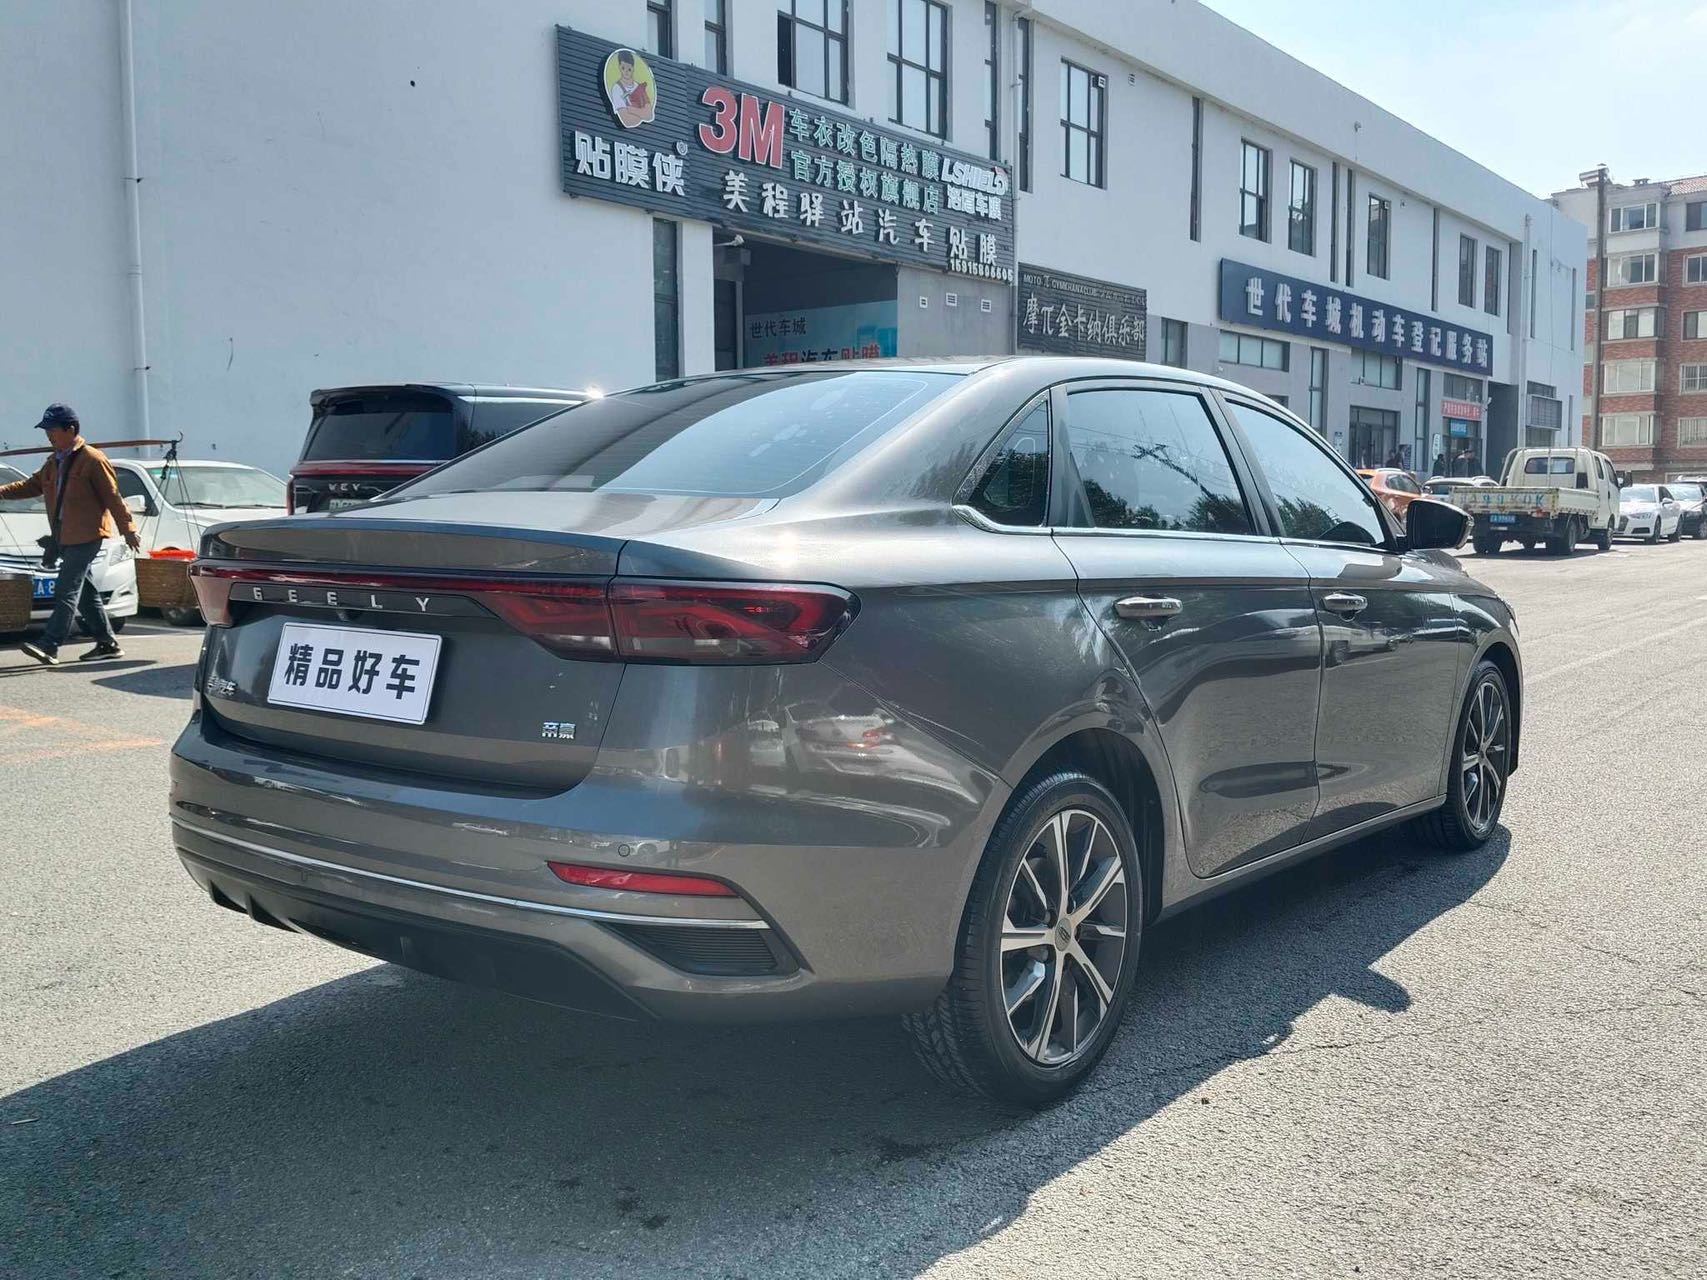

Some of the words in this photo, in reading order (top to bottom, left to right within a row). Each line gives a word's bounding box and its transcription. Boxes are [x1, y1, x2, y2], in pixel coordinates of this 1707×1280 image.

[698, 85, 785, 170] 3M
[789, 108, 940, 182] 车衣改色隔热膜
[575, 130, 686, 197] 贴膜侠
[790, 149, 940, 216] 官方授权旗舰店
[723, 169, 998, 267] 美程驿站汽车贴膜
[751, 316, 807, 339] 世代车城
[1245, 276, 1489, 369] 世代车城机动车登记服务站
[252, 586, 431, 613] GEELY
[284, 643, 421, 701] 精品好车
